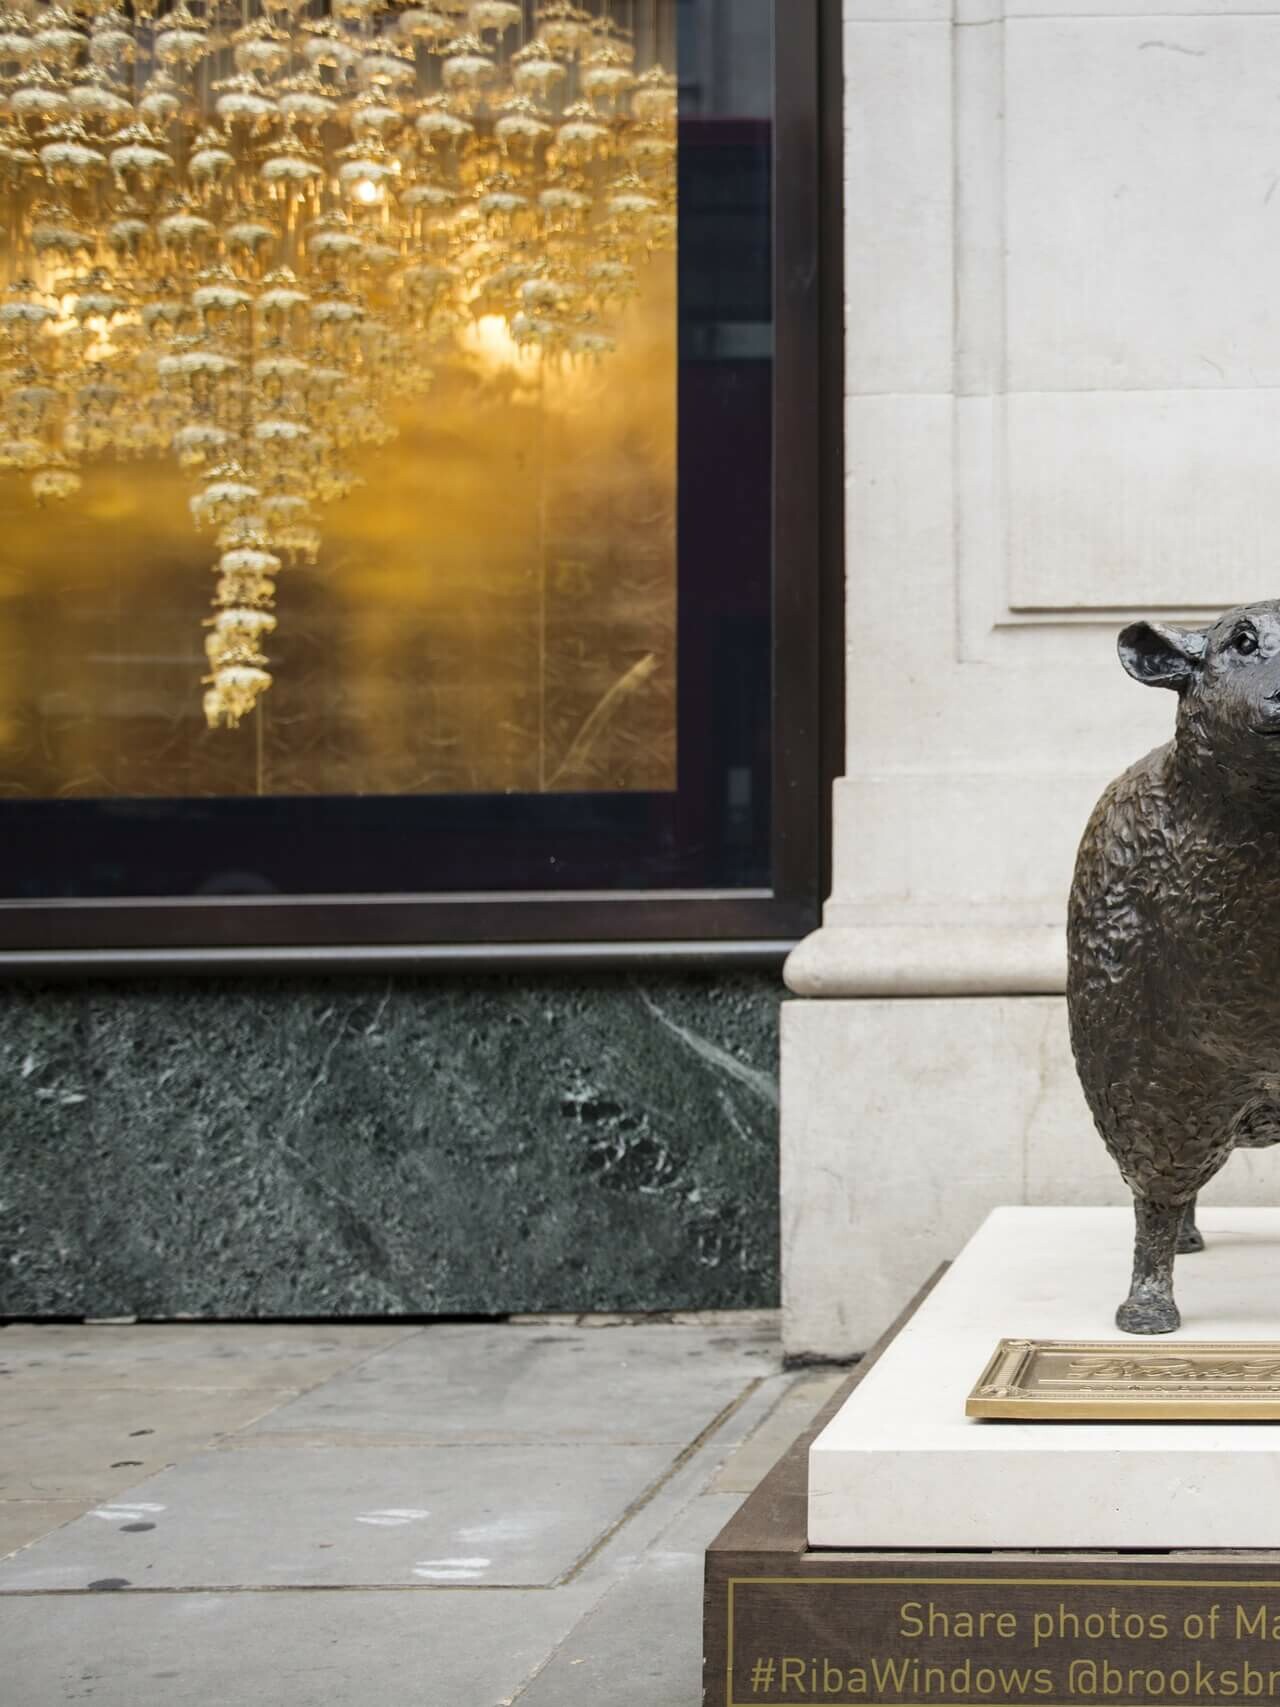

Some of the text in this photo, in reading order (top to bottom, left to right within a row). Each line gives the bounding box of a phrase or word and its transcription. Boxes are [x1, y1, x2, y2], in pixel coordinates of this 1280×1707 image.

[899, 1602, 1017, 1639] Share
[1033, 1604, 1170, 1648] photos
[1184, 1604, 1219, 1640] of
[751, 1657, 1054, 1696] #RibaWindows
